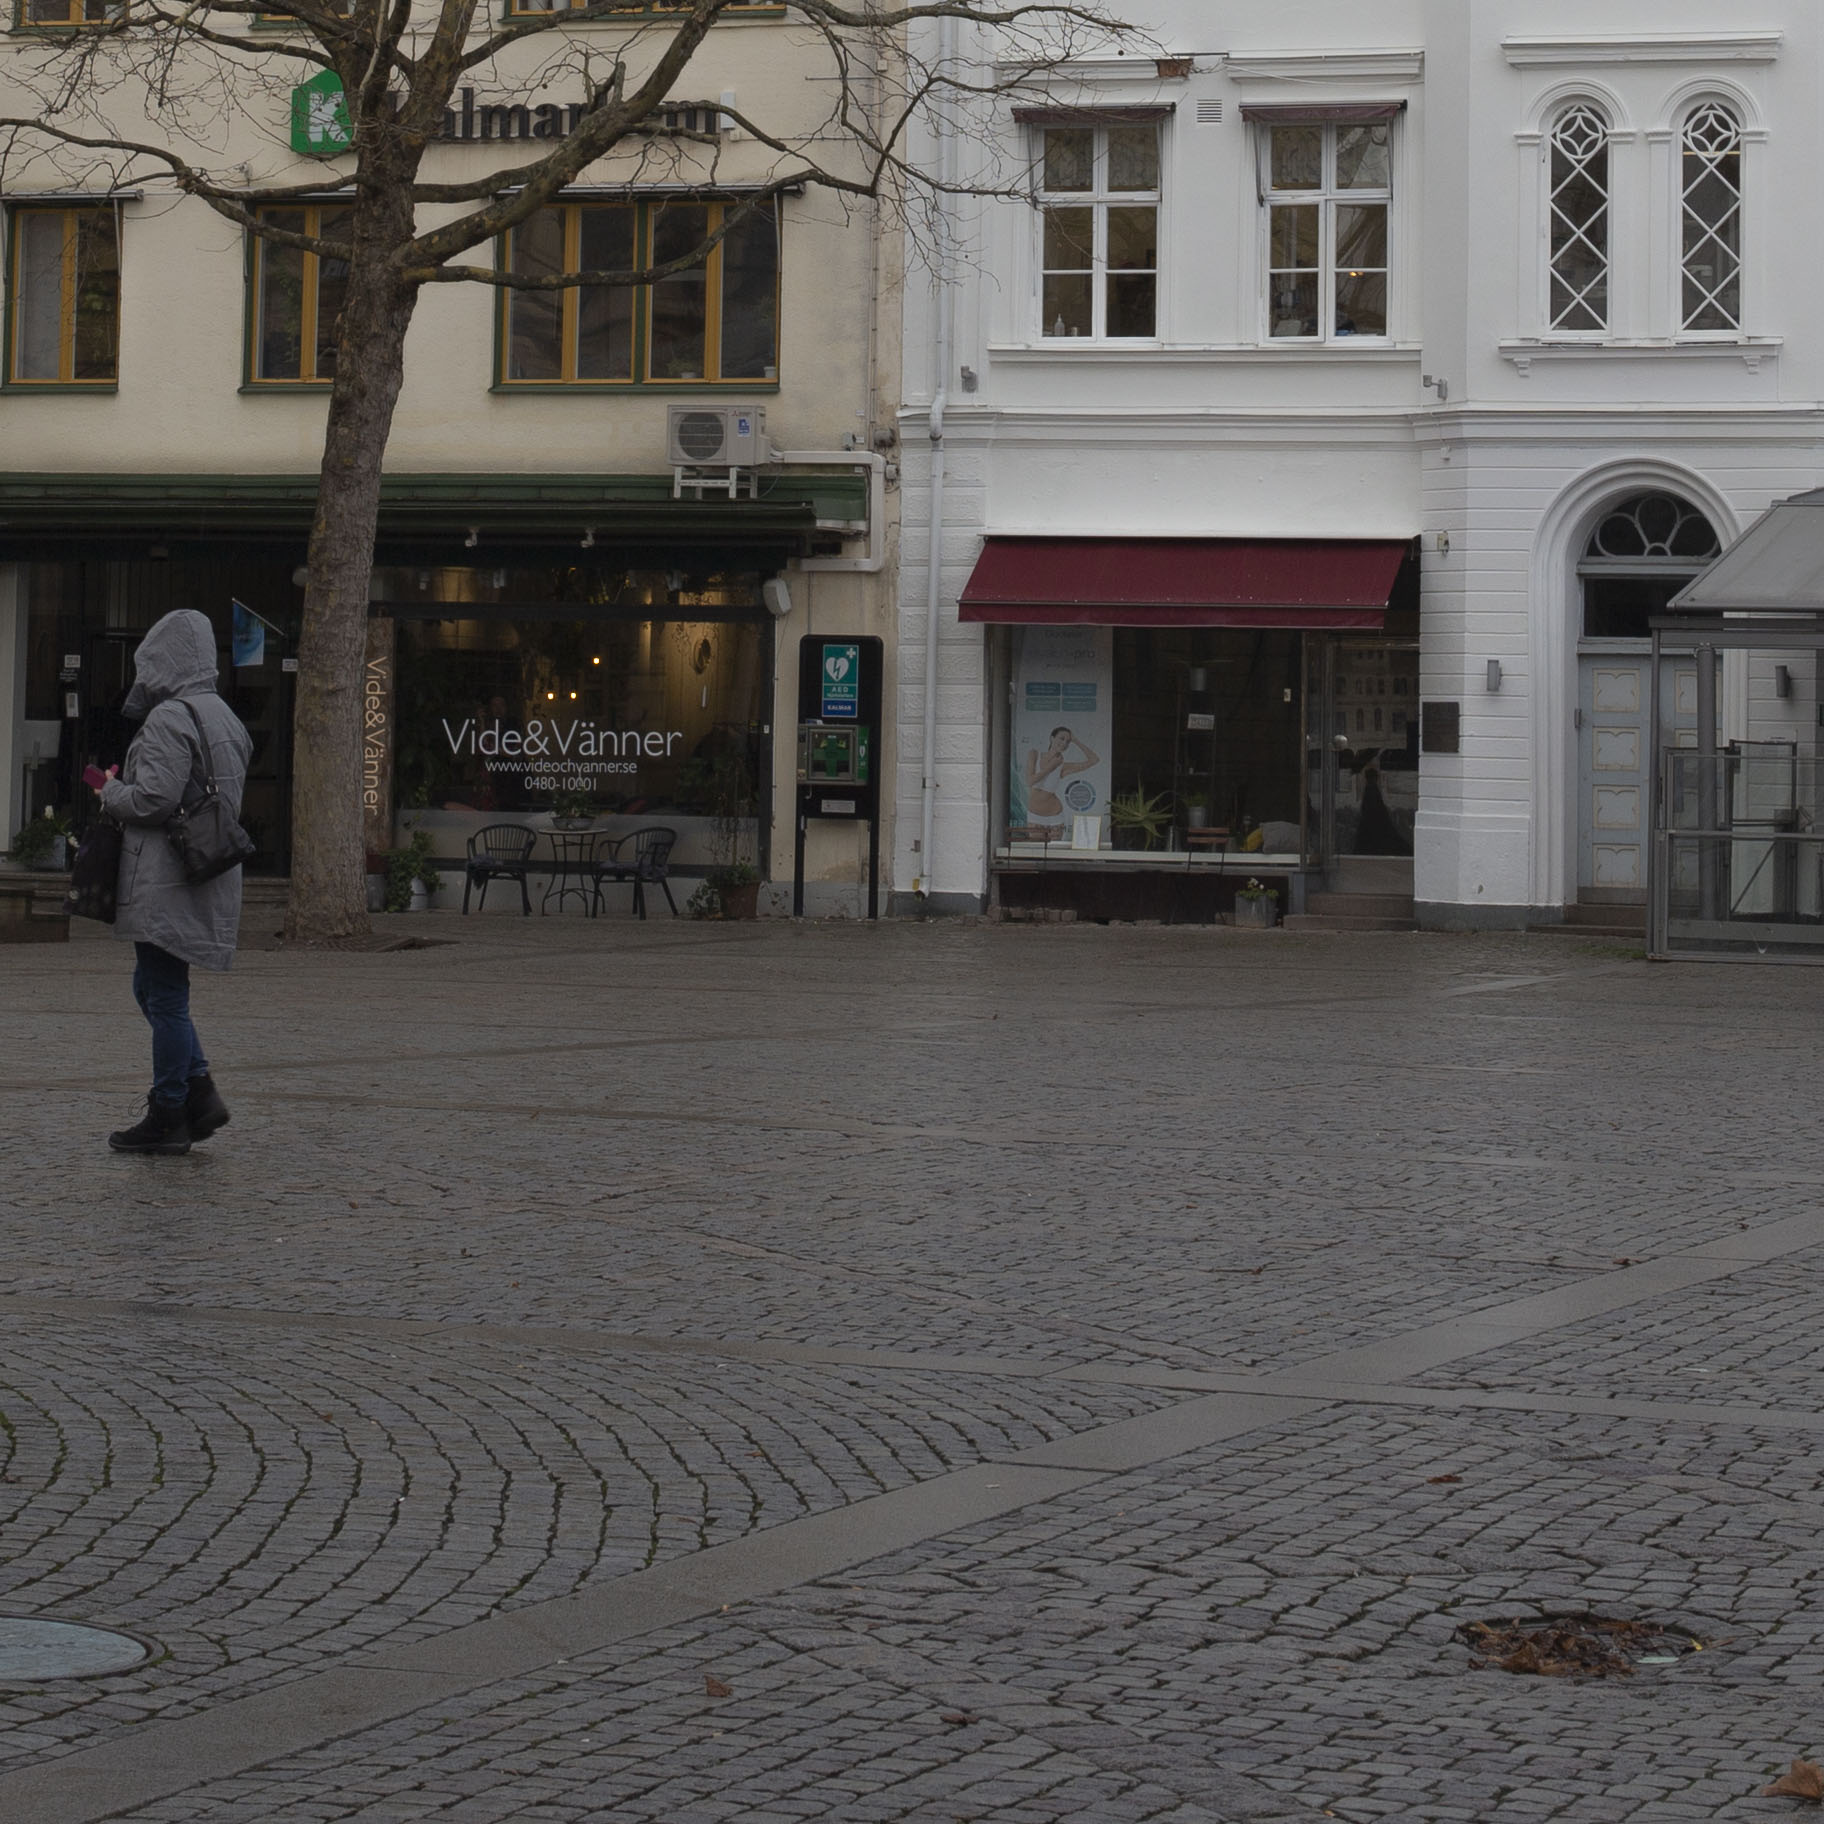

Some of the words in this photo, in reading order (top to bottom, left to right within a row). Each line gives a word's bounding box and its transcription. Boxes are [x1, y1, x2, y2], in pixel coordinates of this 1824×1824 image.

[309, 90, 349, 143] K
[365, 655, 389, 816] Vide&Vänner
[442, 718, 683, 757] Vide&Vänner
[485, 758, 638, 774] www.videochvanner.se
